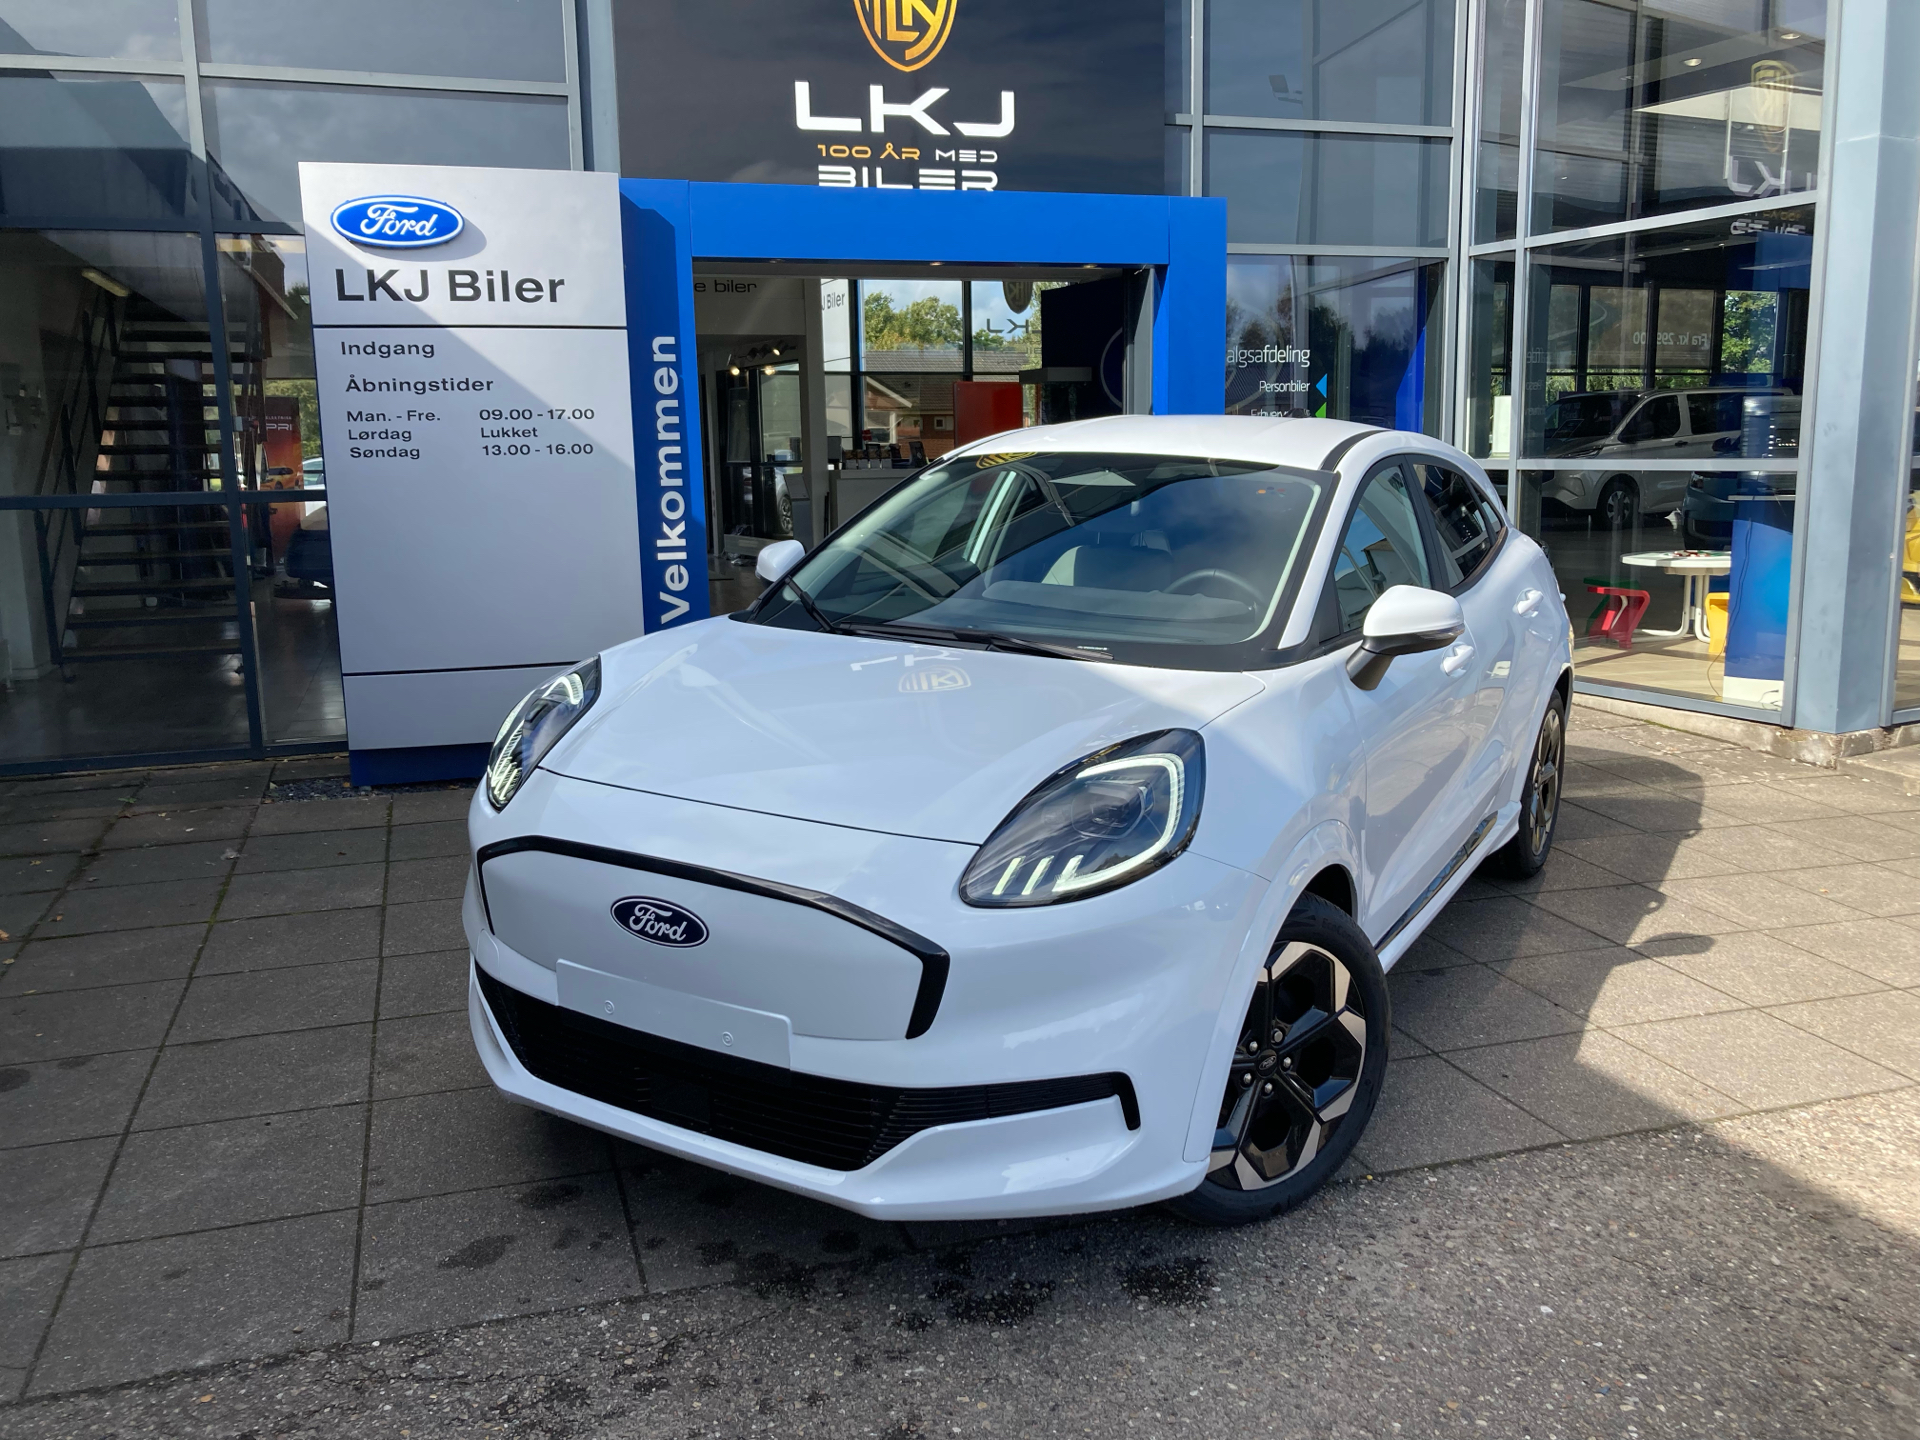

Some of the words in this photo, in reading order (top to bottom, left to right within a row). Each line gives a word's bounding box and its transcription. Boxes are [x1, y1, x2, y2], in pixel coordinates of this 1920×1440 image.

[795, 80, 1015, 138] LKJ
[817, 143, 872, 158] 100
[880, 142, 921, 160] ÅR
[935, 148, 998, 162] MED
[818, 164, 999, 192] BILER
[360, 203, 438, 237] Ford
[335, 268, 430, 302] LKJ
[448, 269, 565, 303] Biler
[714, 279, 758, 293] biler
[827, 291, 846, 310] Biler
[341, 341, 435, 358] Indgang
[345, 374, 494, 395] Åbningstider
[1260, 380, 1310, 392] Personbiler
[346, 410, 391, 422] Man.
[406, 409, 441, 421] Fre.
[479, 408, 533, 421] 09.00
[547, 408, 595, 421] 17.00
[348, 428, 412, 442] Lørdag
[480, 427, 538, 438] Lukket
[349, 447, 420, 460] Søndag
[482, 444, 531, 456] 13.00
[546, 444, 594, 455] 16.00
[652, 335, 690, 625] Velkommen
[629, 903, 688, 941] Ford
